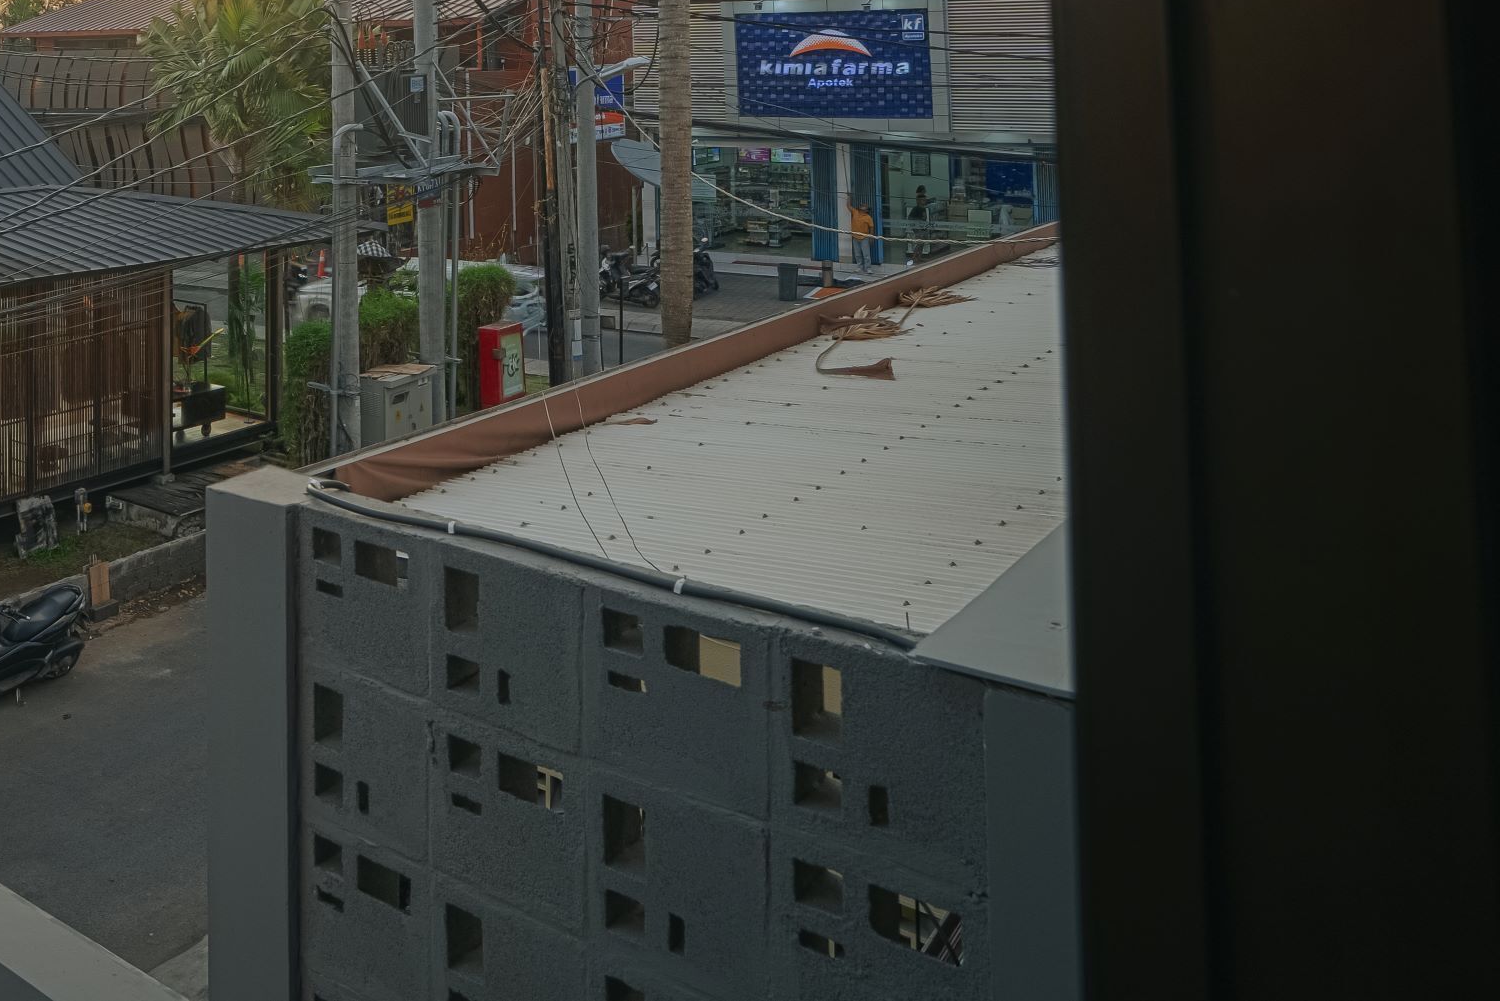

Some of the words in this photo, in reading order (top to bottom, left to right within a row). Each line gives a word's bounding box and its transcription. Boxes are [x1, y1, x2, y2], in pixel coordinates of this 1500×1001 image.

[903, 17, 922, 30] kf
[759, 59, 827, 75] kimia
[831, 59, 910, 75] farma
[808, 78, 854, 89] Apotek
